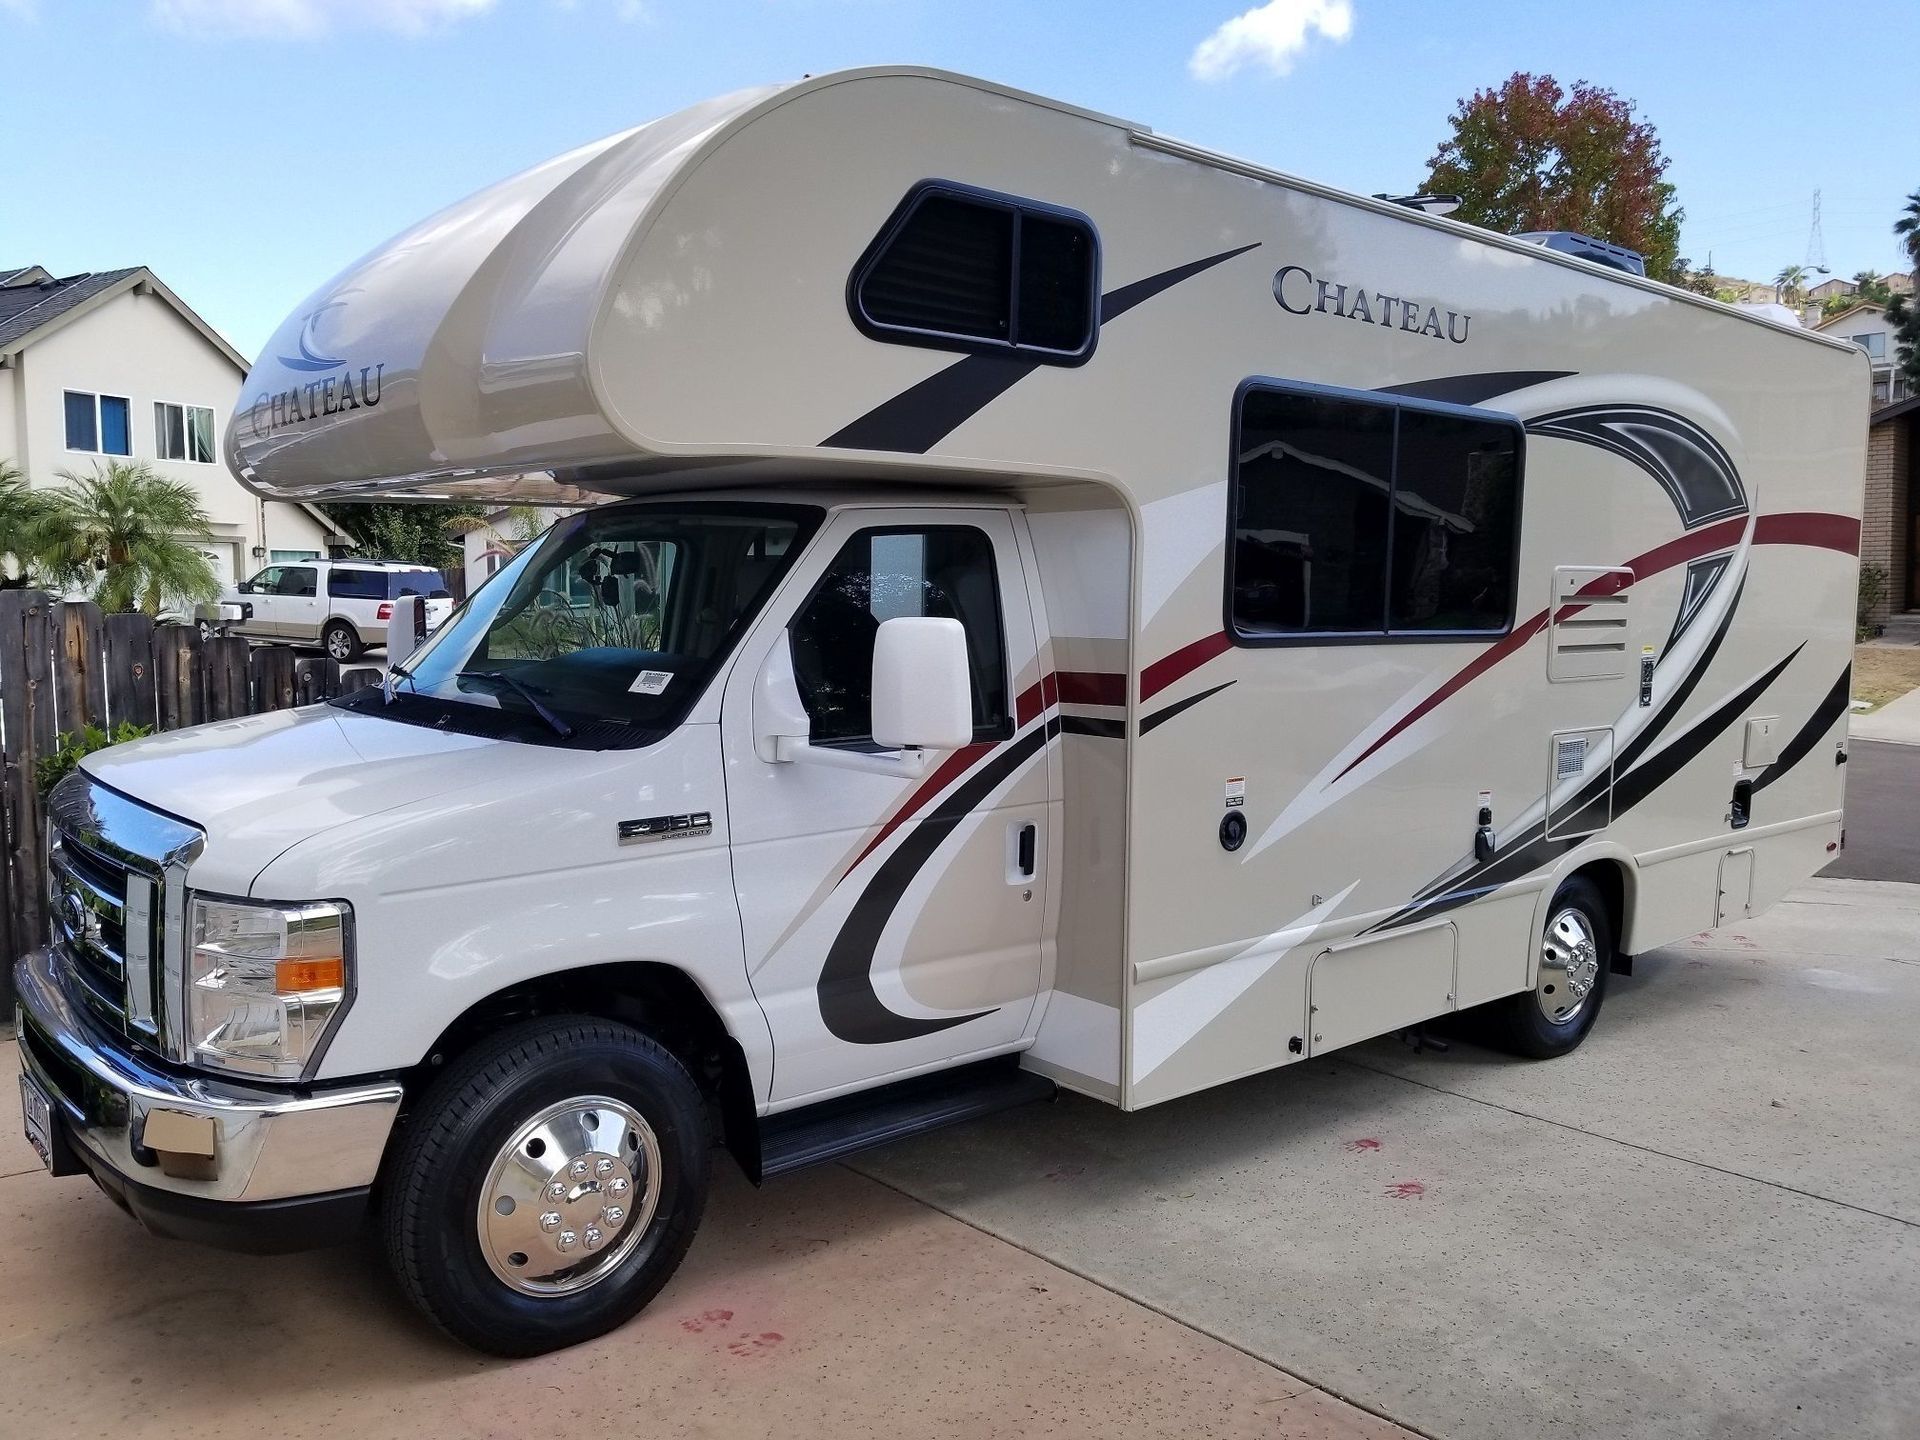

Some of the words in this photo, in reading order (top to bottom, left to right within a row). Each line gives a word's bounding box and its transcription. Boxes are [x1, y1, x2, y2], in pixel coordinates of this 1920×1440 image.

[1272, 265, 1471, 344] CHATEAU
[252, 363, 385, 438] CHATEAU
[661, 831, 688, 840] SUPER
